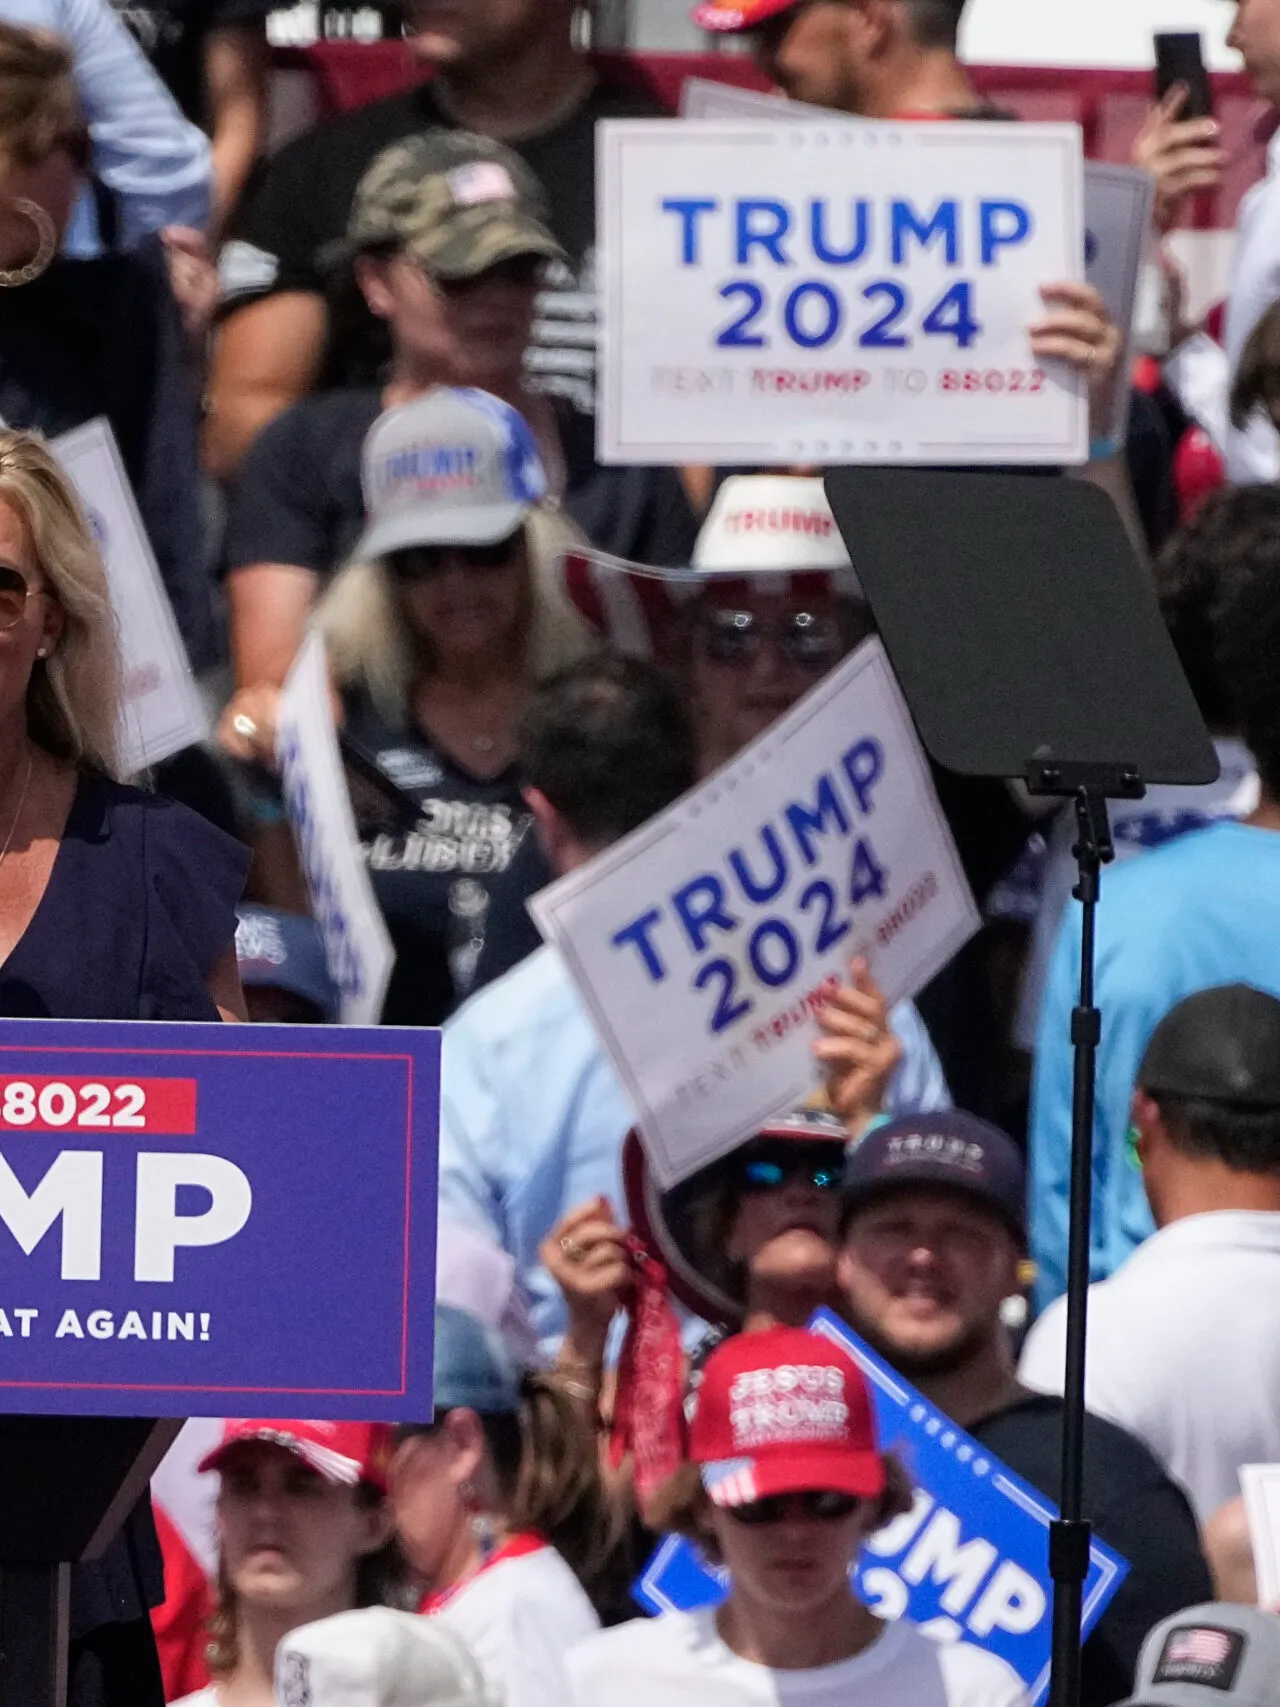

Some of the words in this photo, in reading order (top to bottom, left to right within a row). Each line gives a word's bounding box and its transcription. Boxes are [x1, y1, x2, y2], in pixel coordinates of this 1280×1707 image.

[662, 199, 1031, 266] TRUMP
[715, 280, 980, 348] 2024
[751, 367, 870, 394] TRUMP
[937, 367, 1047, 394] 88022
[610, 735, 887, 984] TRUMP
[692, 836, 888, 1035] 2024
[55, 1310, 211, 1340] AGAIN!
[863, 1487, 1046, 1637] UMP
